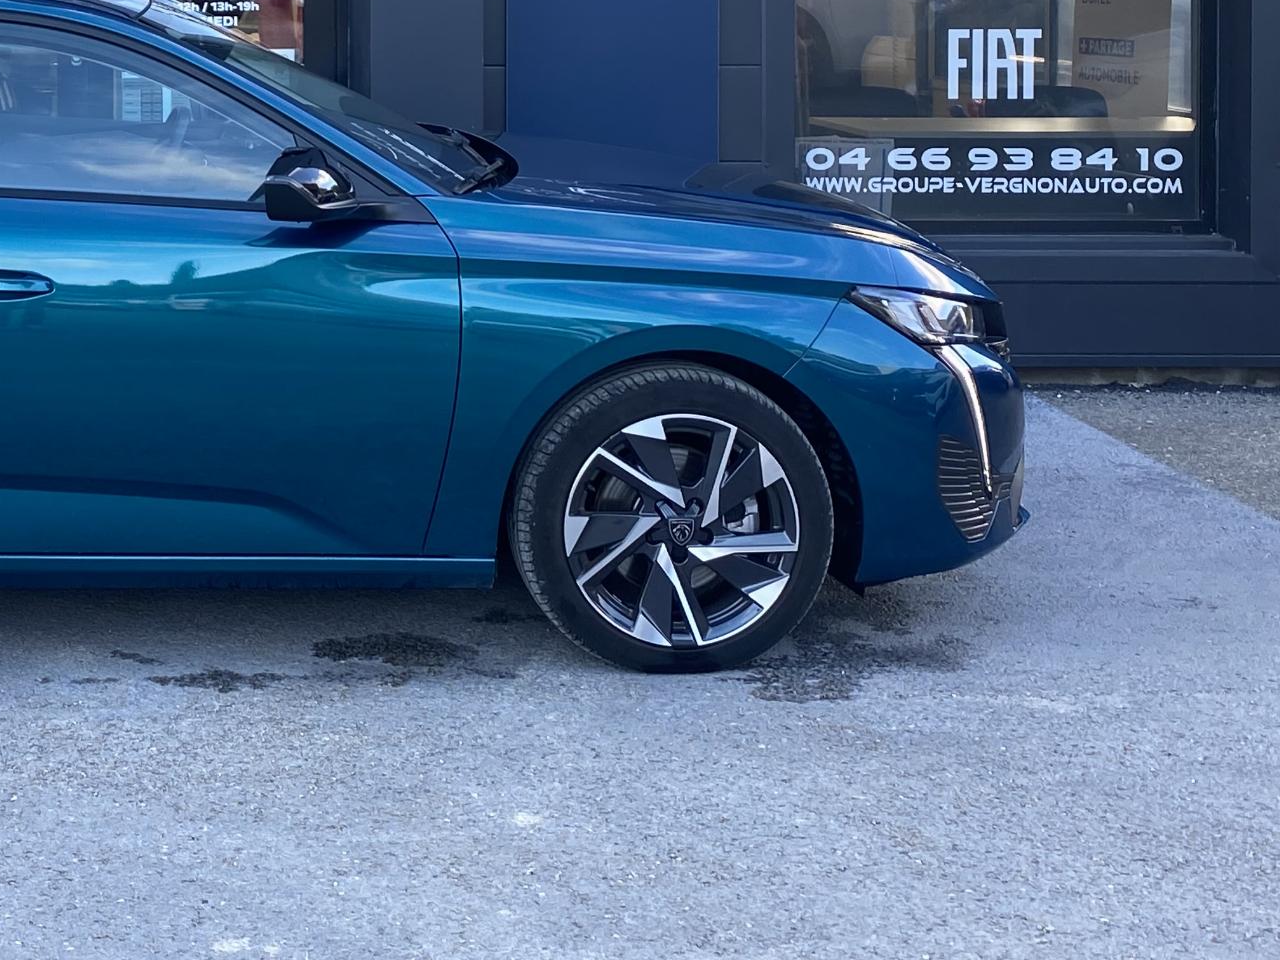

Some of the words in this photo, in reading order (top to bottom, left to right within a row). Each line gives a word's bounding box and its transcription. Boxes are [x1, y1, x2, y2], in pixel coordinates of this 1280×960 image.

[210, 1, 260, 12] 13h-19h
[947, 28, 1042, 100] FIAT
[805, 147, 871, 171] 04
[887, 147, 951, 171] 66
[968, 147, 1034, 171] 93
[1050, 147, 1118, 171] 84
[1135, 147, 1184, 171] 10
[805, 176, 1183, 194] WWW.GROUPE-VERGNONAUTO.COM
